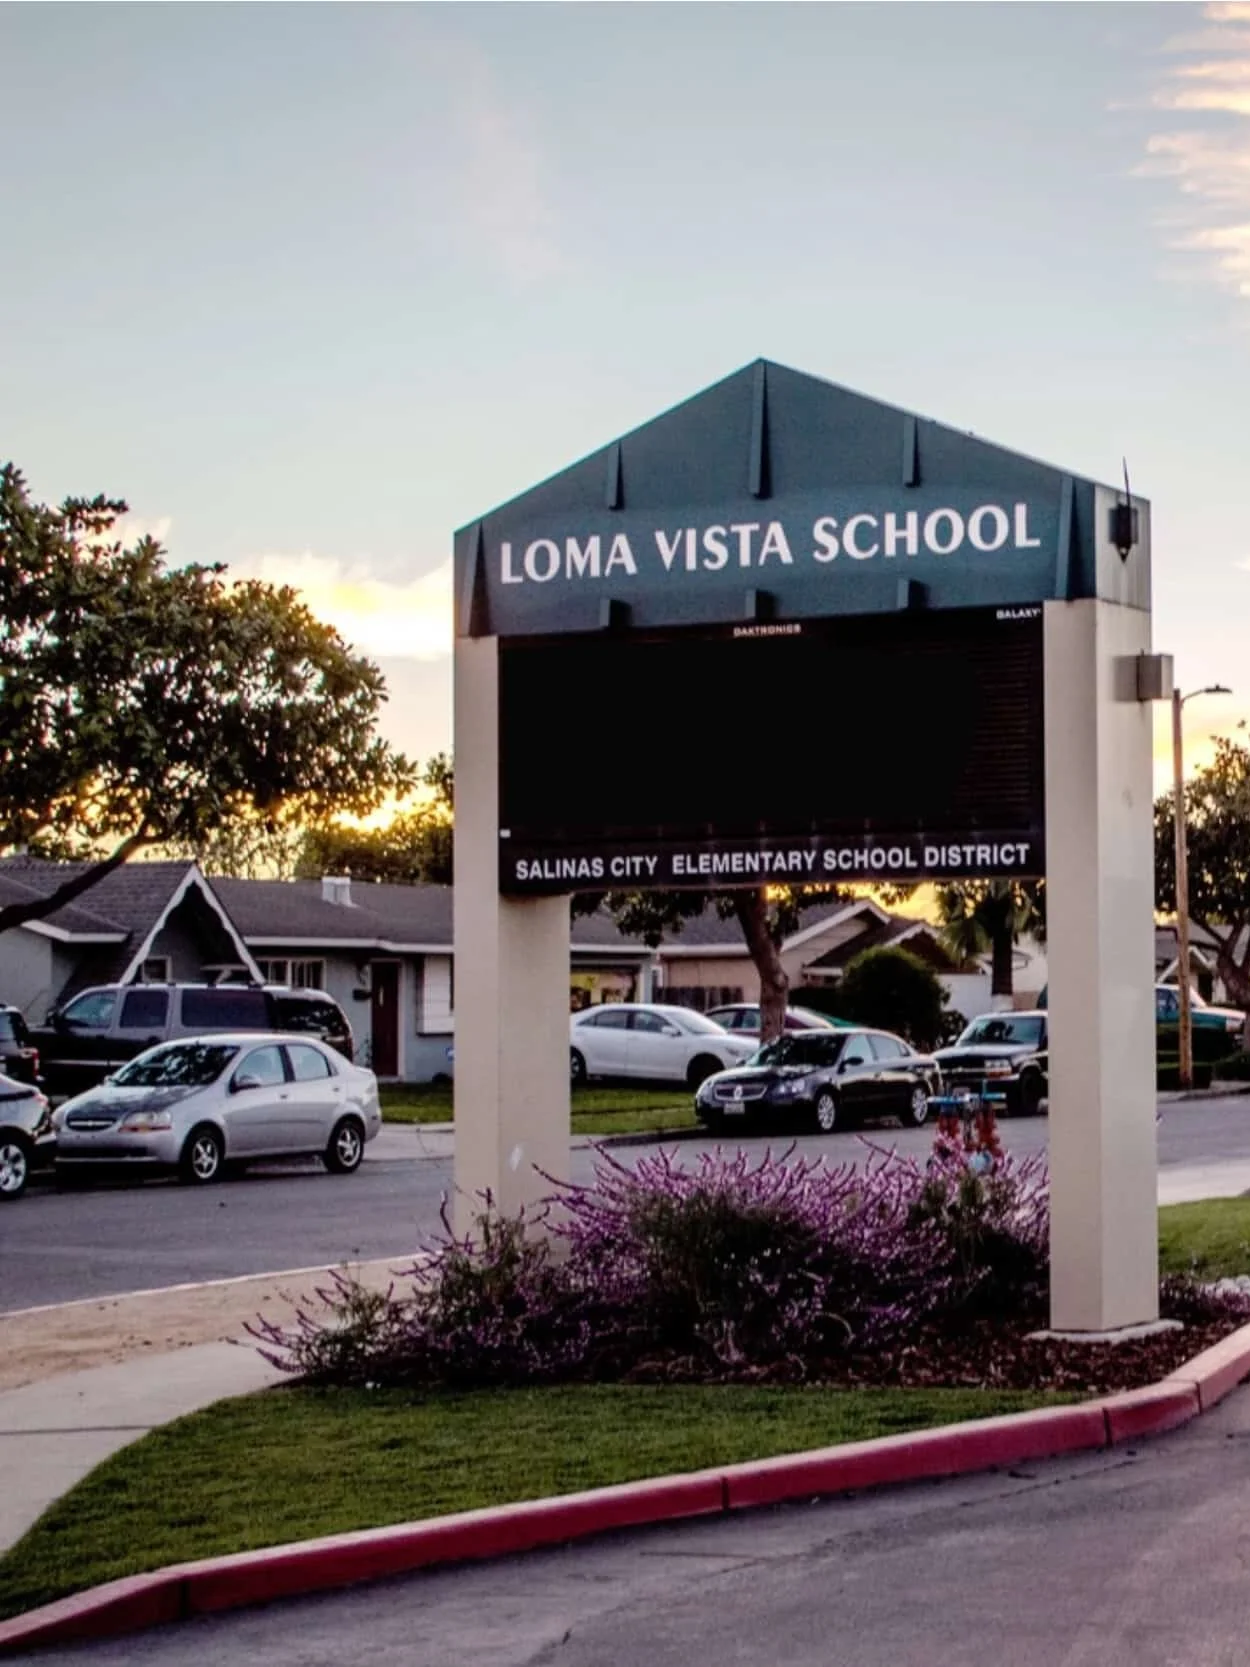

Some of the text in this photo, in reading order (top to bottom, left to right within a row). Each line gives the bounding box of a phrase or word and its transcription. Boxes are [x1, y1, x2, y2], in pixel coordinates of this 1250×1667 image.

[500, 503, 1041, 585] LOMA VISTA SCHOOL
[996, 608, 1040, 620] GALAXY
[733, 623, 802, 638] DAKTRONICS
[515, 843, 1030, 880] SALINAS CITY ELEMENTARY SCHOOL DISTRICT
